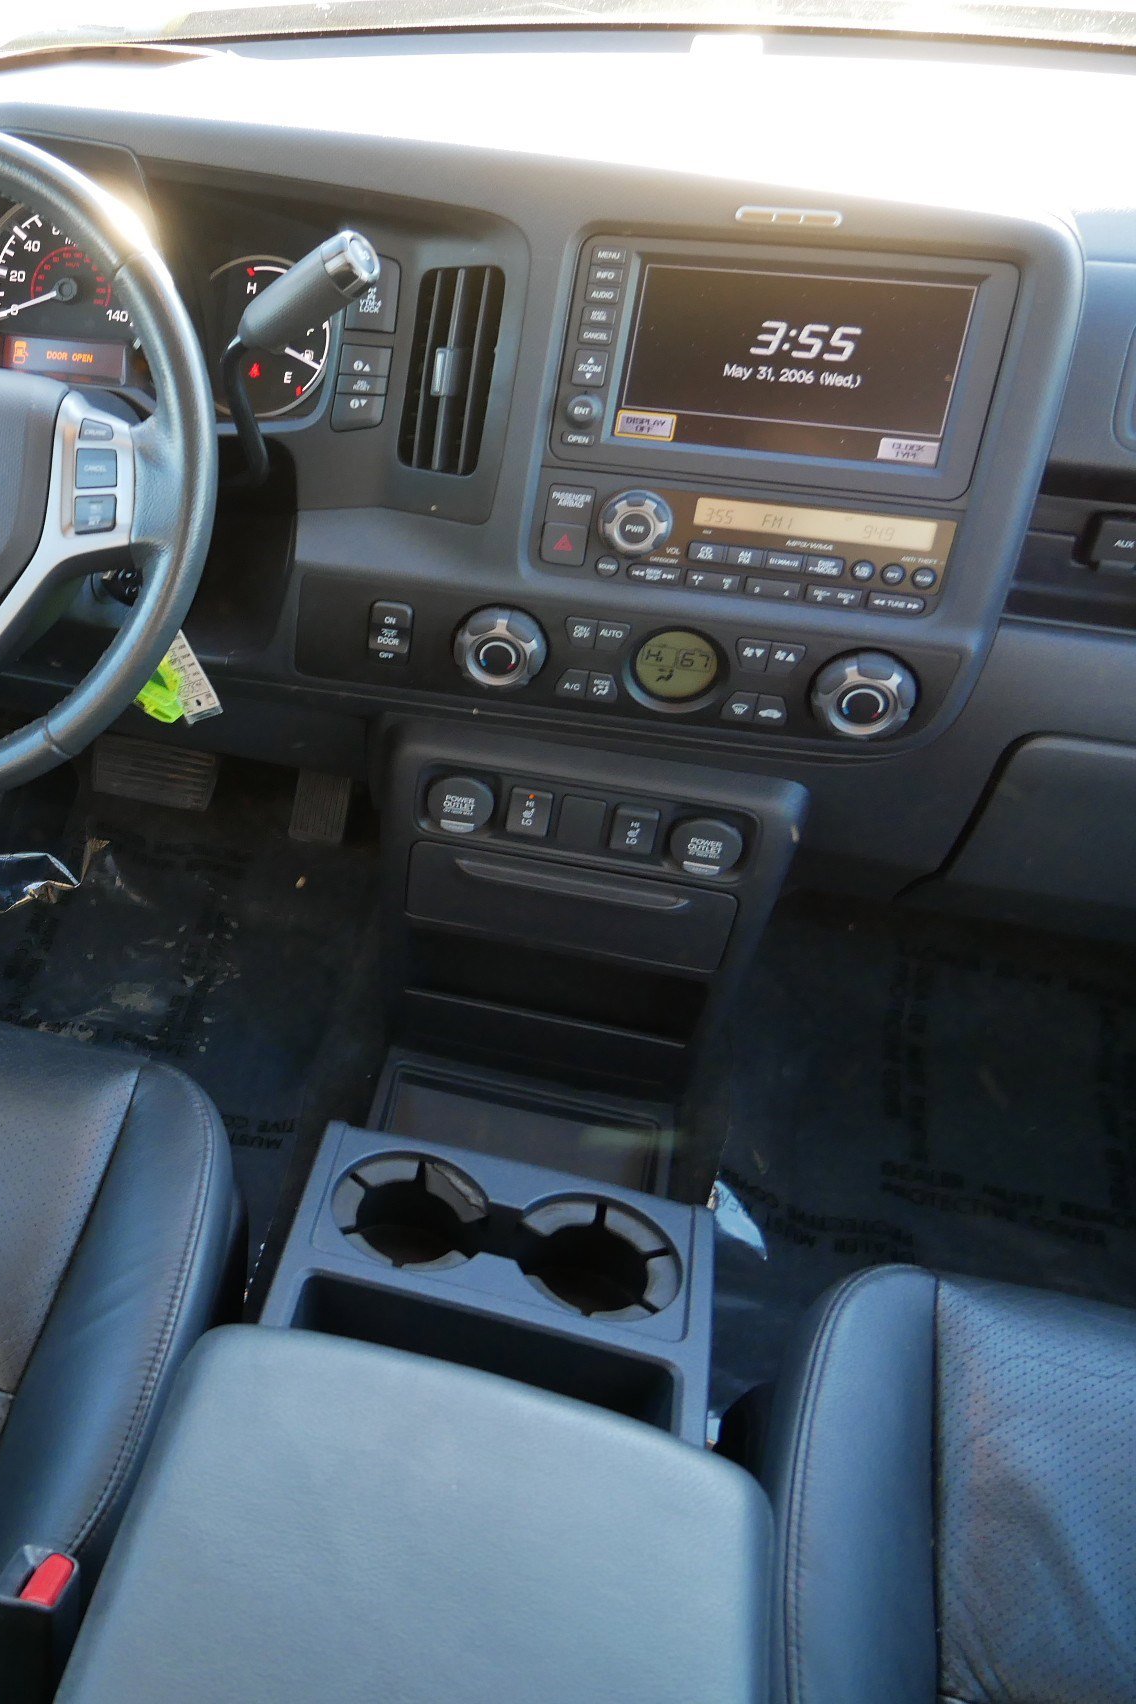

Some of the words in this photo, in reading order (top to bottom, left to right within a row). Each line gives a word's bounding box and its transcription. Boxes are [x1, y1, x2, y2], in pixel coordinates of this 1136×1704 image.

[24, 241, 40, 252] 40
[597, 250, 621, 260] MENU
[9, 271, 25, 282] 20
[596, 270, 615, 280] INFO
[246, 282, 257, 294] H
[590, 290, 614, 300] AUDIO
[106, 310, 128, 322] 140
[749, 320, 862, 362] 3:55
[46, 350, 68, 361] DOOR
[72, 353, 94, 363] OPEN
[577, 363, 602, 373] ZOOM
[283, 371, 293, 384] E
[723, 363, 752, 381] May
[756, 366, 775, 382] 31,
[779, 367, 814, 384] 2006
[574, 406, 591, 415] ENT
[567, 434, 590, 444] OPEN
[625, 524, 645, 534] PWR
[666, 547, 681, 555] VOL
[887, 599, 906, 609] TUNE
[384, 616, 397, 625] ON
[599, 628, 624, 639] AUTO
[377, 635, 400, 646] DOOR
[379, 651, 394, 659] OFF
[680, 652, 710, 668] 67
[564, 682, 581, 691] A/C
[446, 794, 475, 803] POWER
[443, 800, 476, 811] OUTLET
[521, 818, 532, 826] LO
[625, 837, 637, 845] LO
[691, 837, 723, 847] POWER
[687, 843, 722, 854] OUTLET
